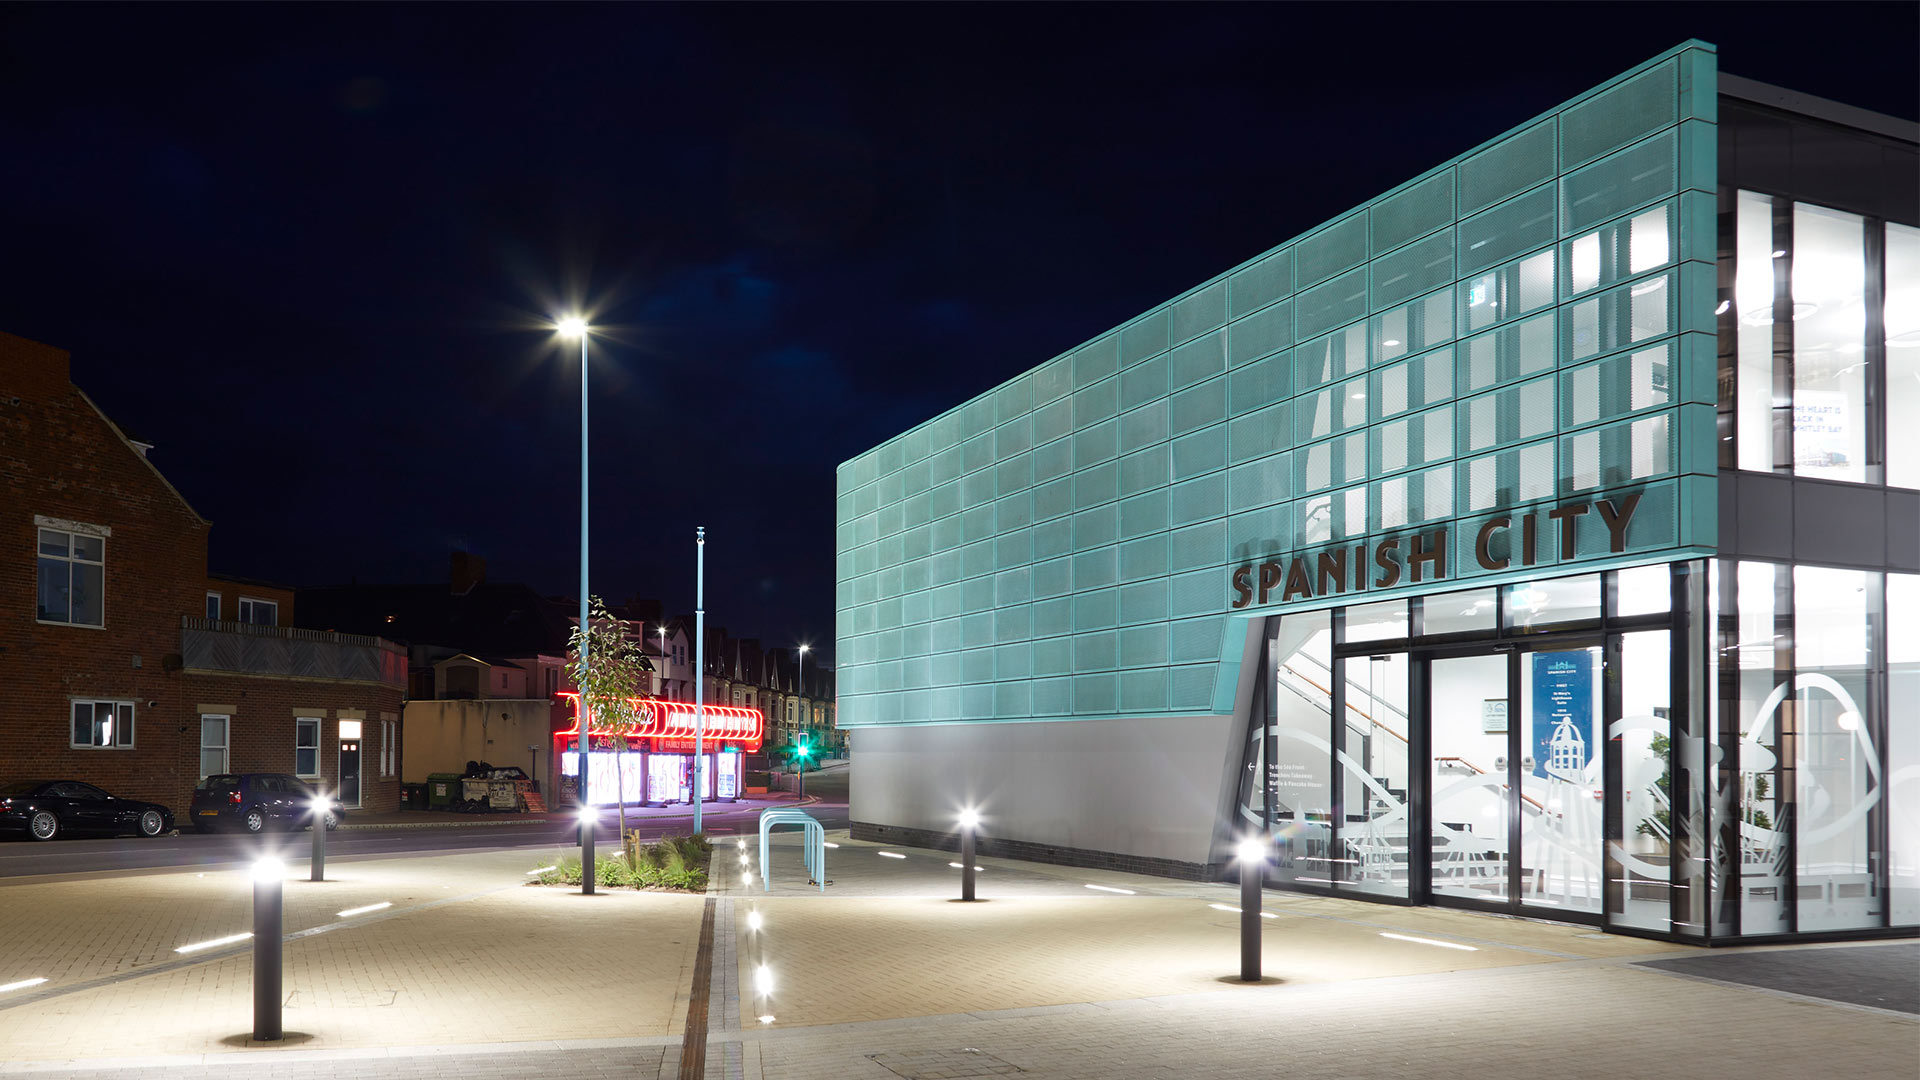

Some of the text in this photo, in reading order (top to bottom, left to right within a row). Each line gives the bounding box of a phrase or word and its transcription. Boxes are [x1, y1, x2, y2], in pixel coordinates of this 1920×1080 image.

[1232, 493, 1643, 608] SPANISH CITY
[665, 740, 714, 750] FAMILY ENTERTMENT
